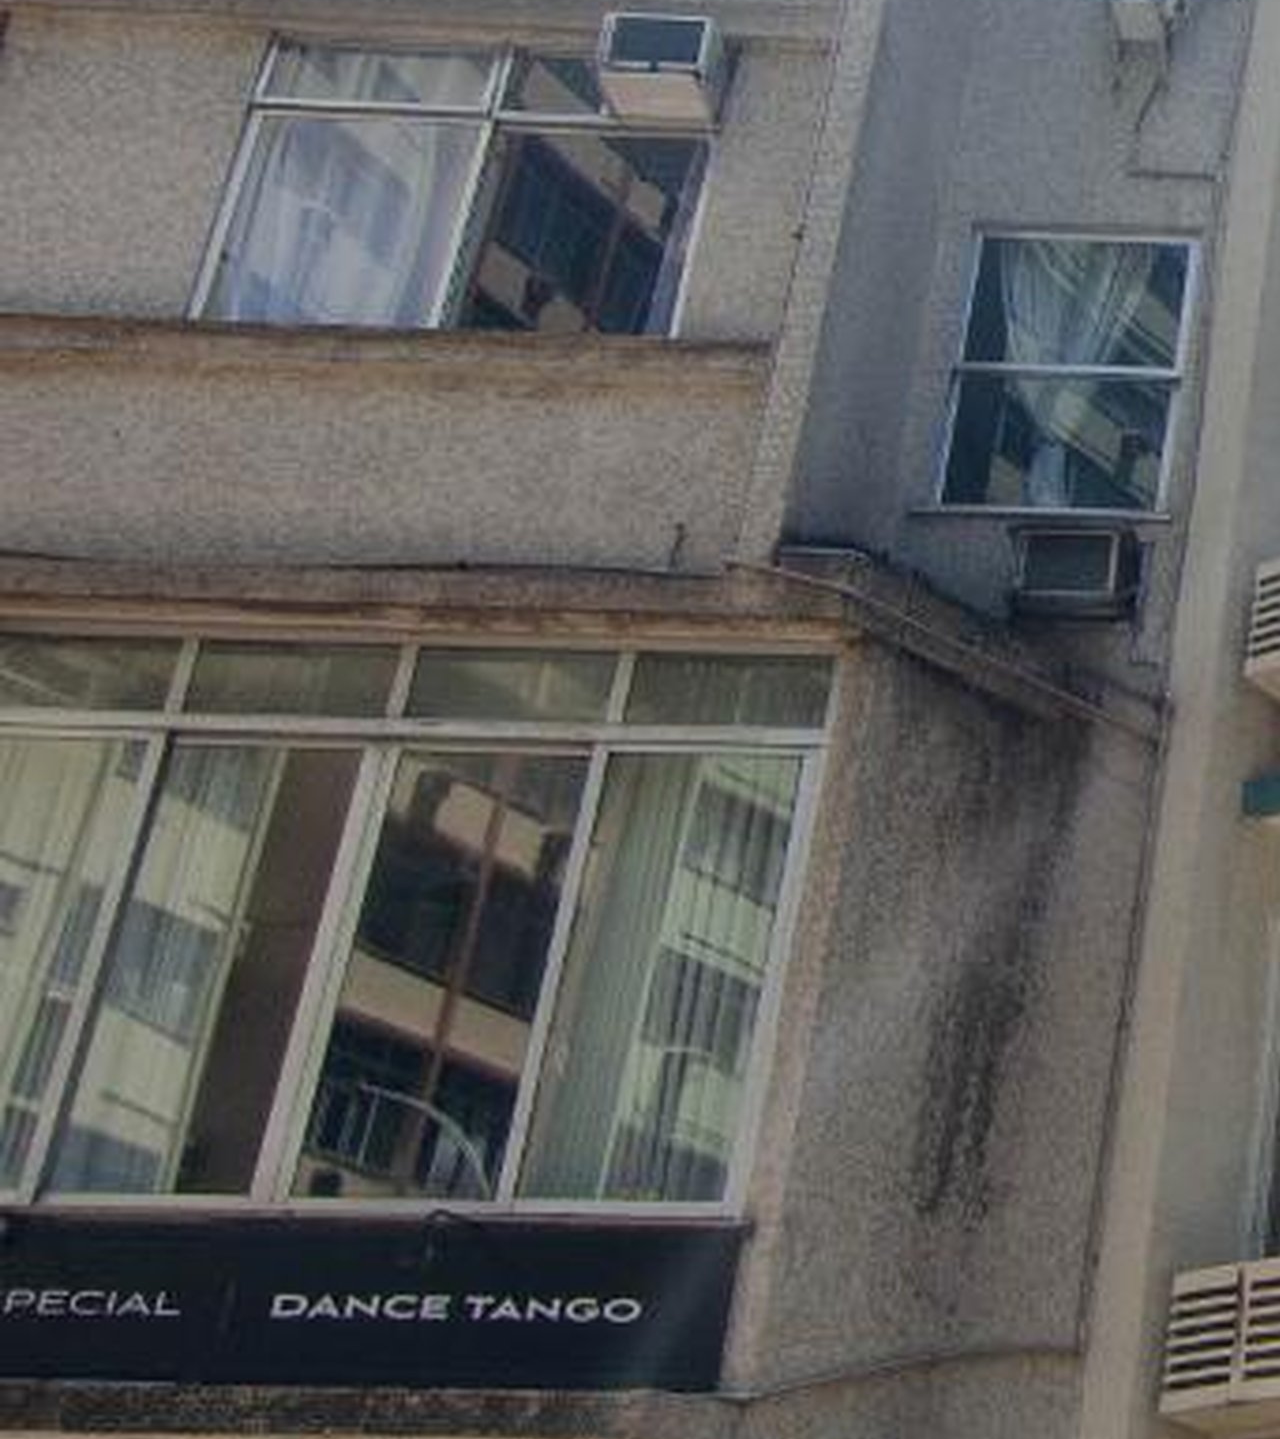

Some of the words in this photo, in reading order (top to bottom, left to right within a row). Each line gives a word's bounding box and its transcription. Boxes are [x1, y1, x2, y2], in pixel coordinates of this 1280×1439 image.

[0, 1288, 180, 1317] PECIAL
[270, 1293, 451, 1321] DANCE
[465, 1295, 642, 1324] TANGO
